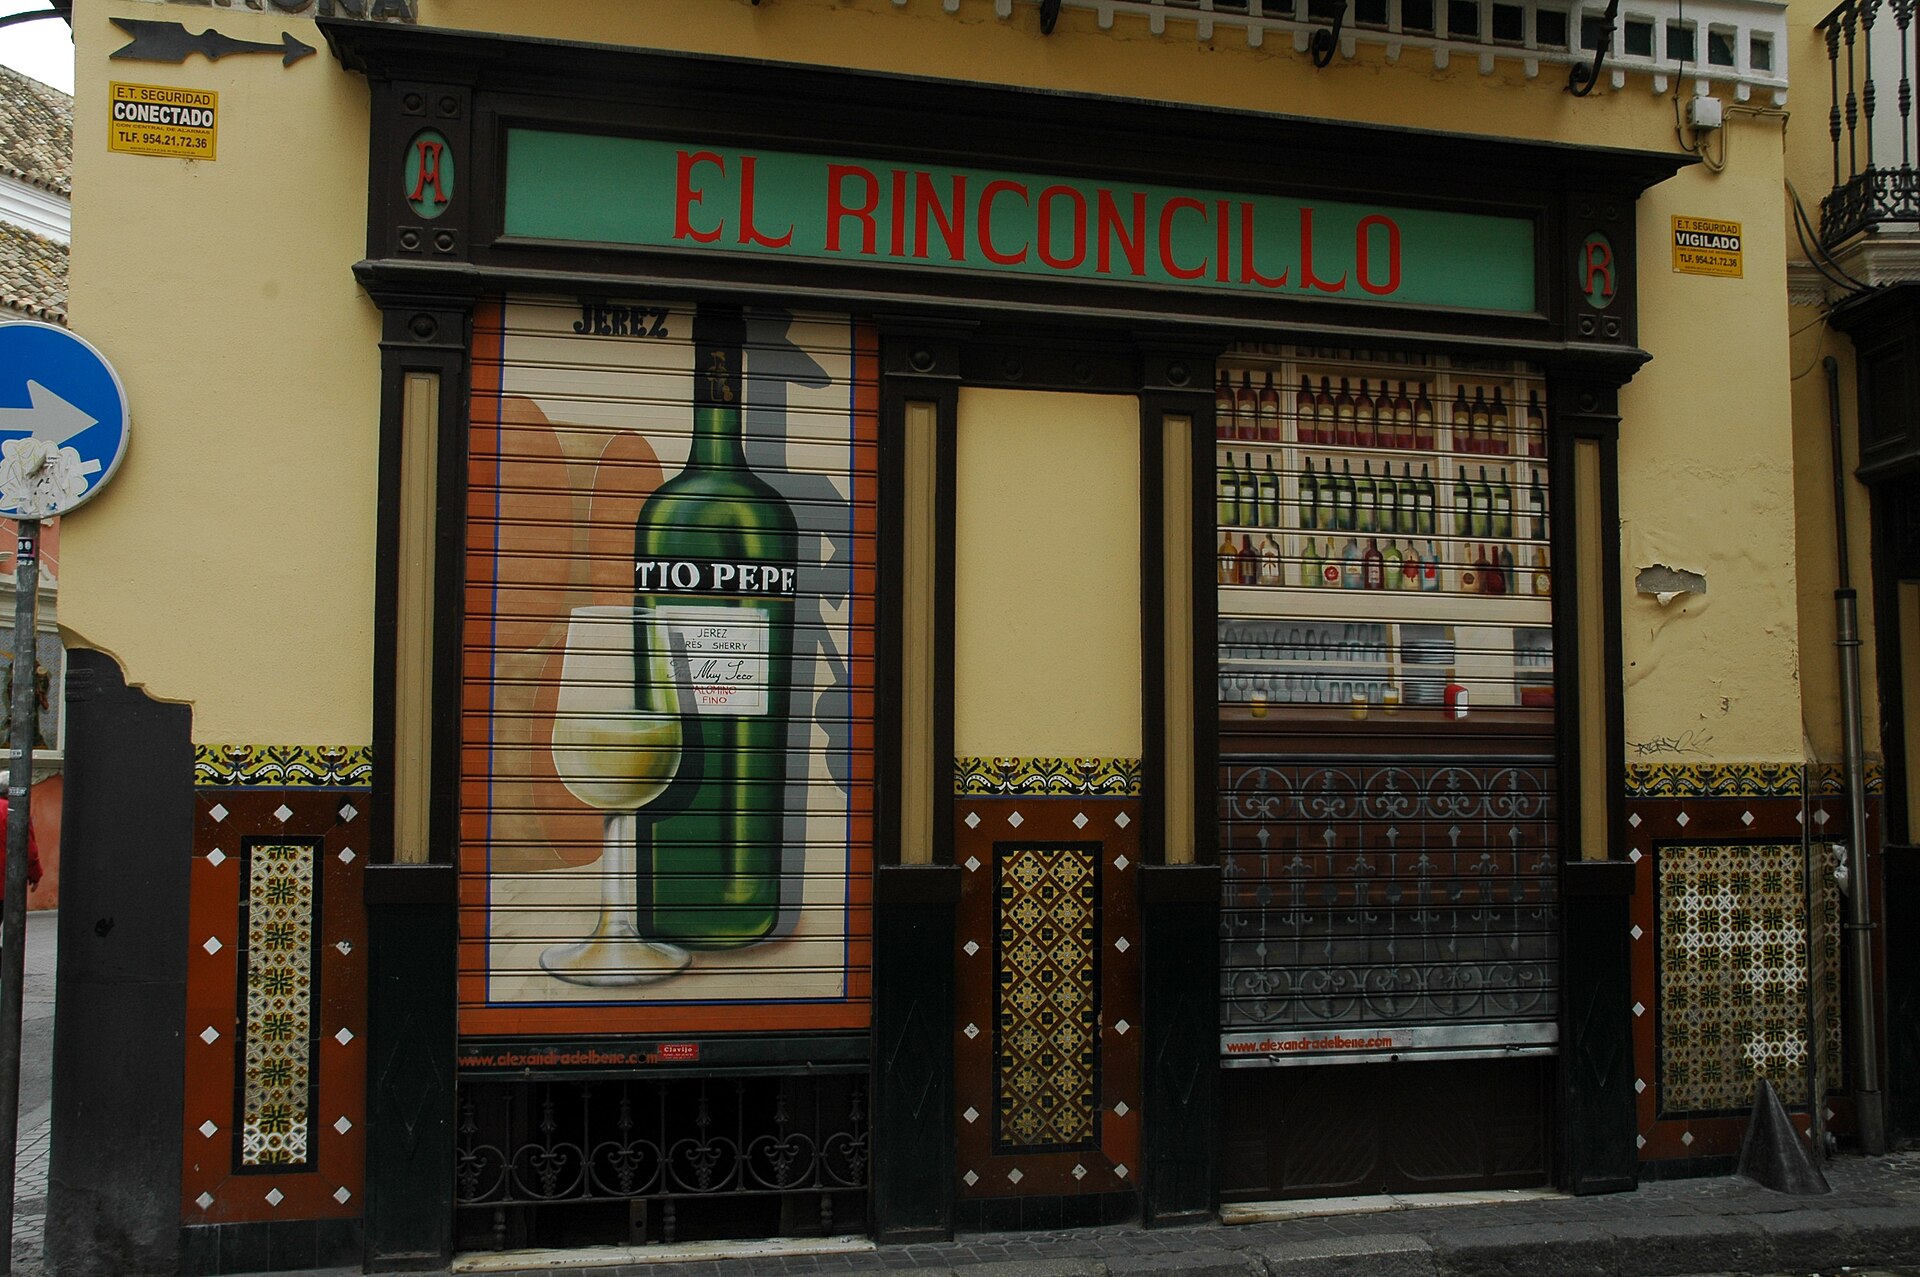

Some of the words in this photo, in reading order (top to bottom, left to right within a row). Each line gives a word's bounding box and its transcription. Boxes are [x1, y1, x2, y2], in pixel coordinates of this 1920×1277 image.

[117, 87, 137, 99] E.T.
[141, 89, 211, 105] SEGURIDAD
[114, 102, 213, 127] CONECTADO
[118, 131, 140, 143] TLF.
[143, 133, 208, 149] 954.21.72.36
[409, 141, 448, 204] A
[673, 150, 794, 249] EL
[825, 164, 1402, 296] RINCONCILLO
[1692, 221, 1738, 234] SEGURIDAD
[1676, 232, 1740, 250] VIGILADO
[1584, 243, 1611, 296] R
[1680, 254, 1694, 263] TLF.
[1695, 255, 1738, 268] 954.21.72.36
[573, 303, 669, 337] JEREZ
[635, 561, 701, 591] TIO
[710, 562, 795, 595] PEPE
[697, 629, 728, 639] JEREZ
[712, 642, 748, 651] SHERRY
[693, 659, 722, 683] Muy
[725, 660, 754, 680] Seco
[702, 696, 728, 704] FINO
[457, 1049, 658, 1067] www.alexandradelbene.cm
